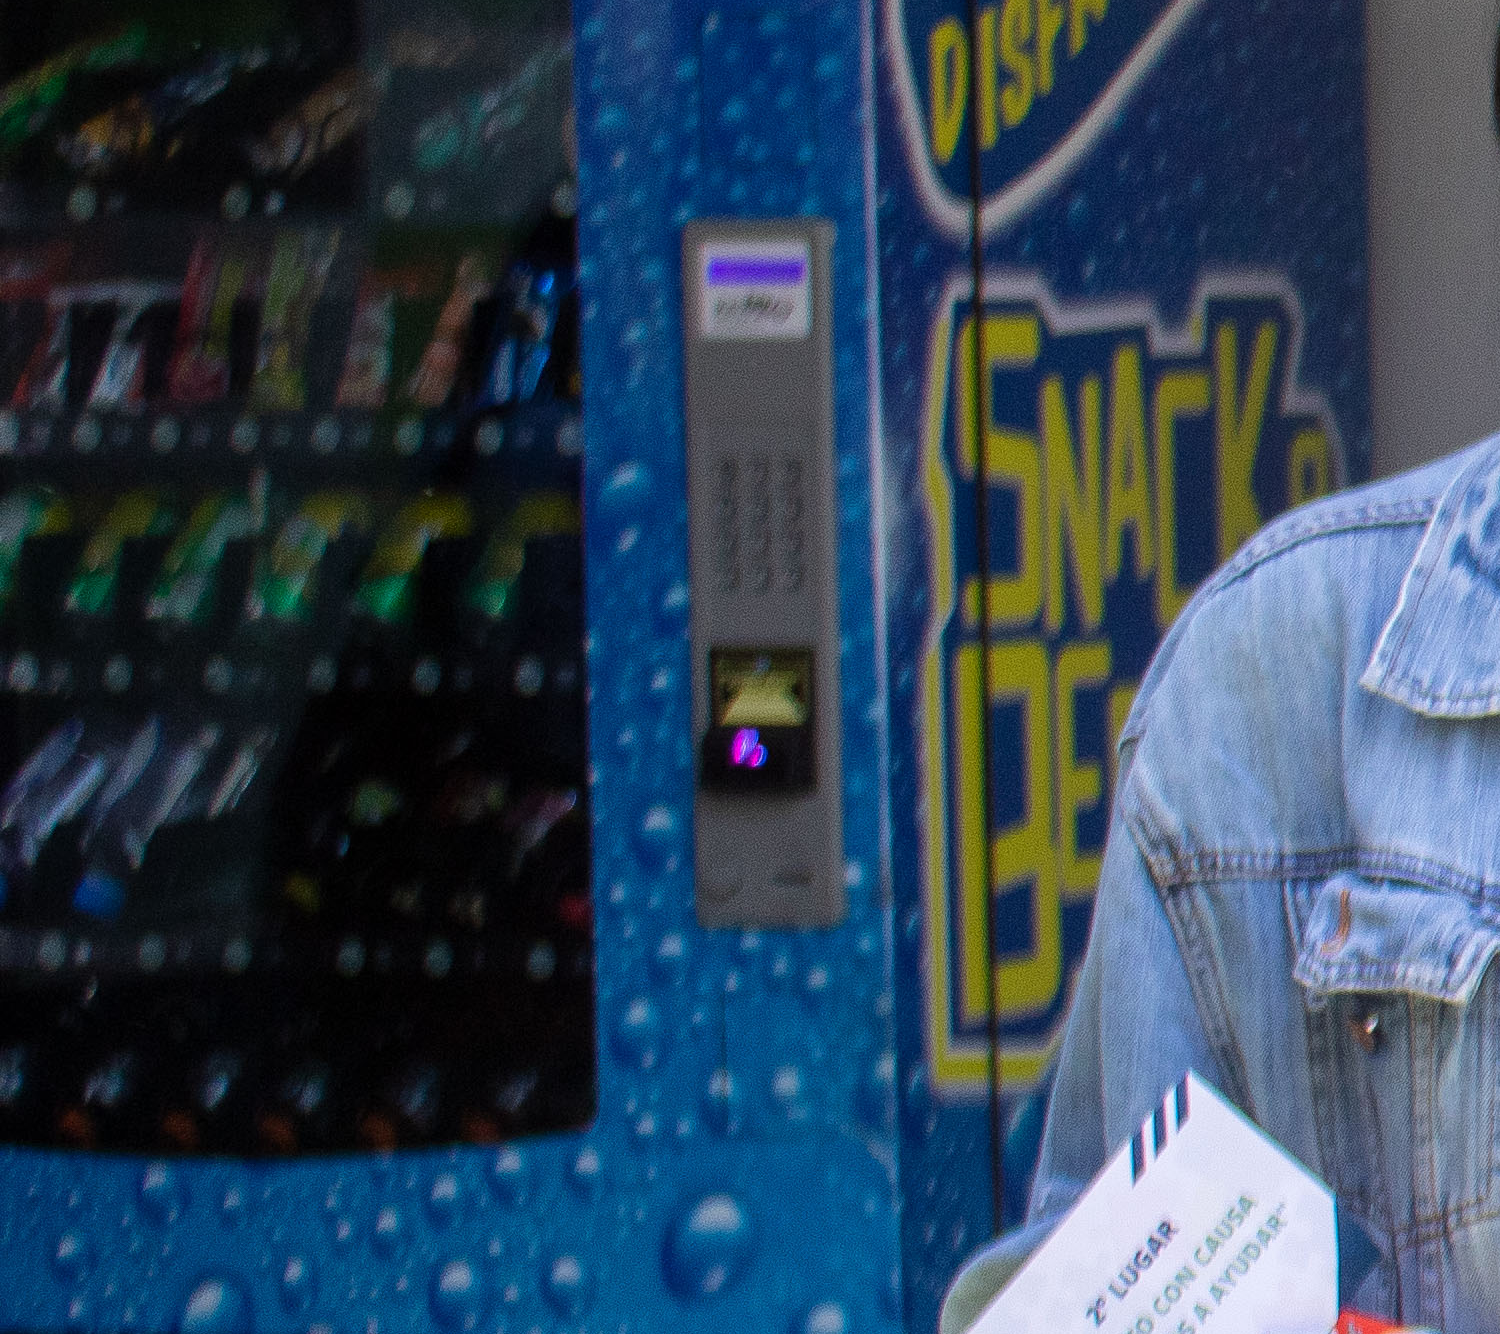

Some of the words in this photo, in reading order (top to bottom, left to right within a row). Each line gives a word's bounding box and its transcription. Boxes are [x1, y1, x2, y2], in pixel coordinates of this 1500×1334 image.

[1109, 1219, 1178, 1299] LUGAR
[1154, 1267, 1196, 1314] CON
[1195, 1196, 1256, 1265] CAUSA
[1194, 1302, 1212, 1326] A
